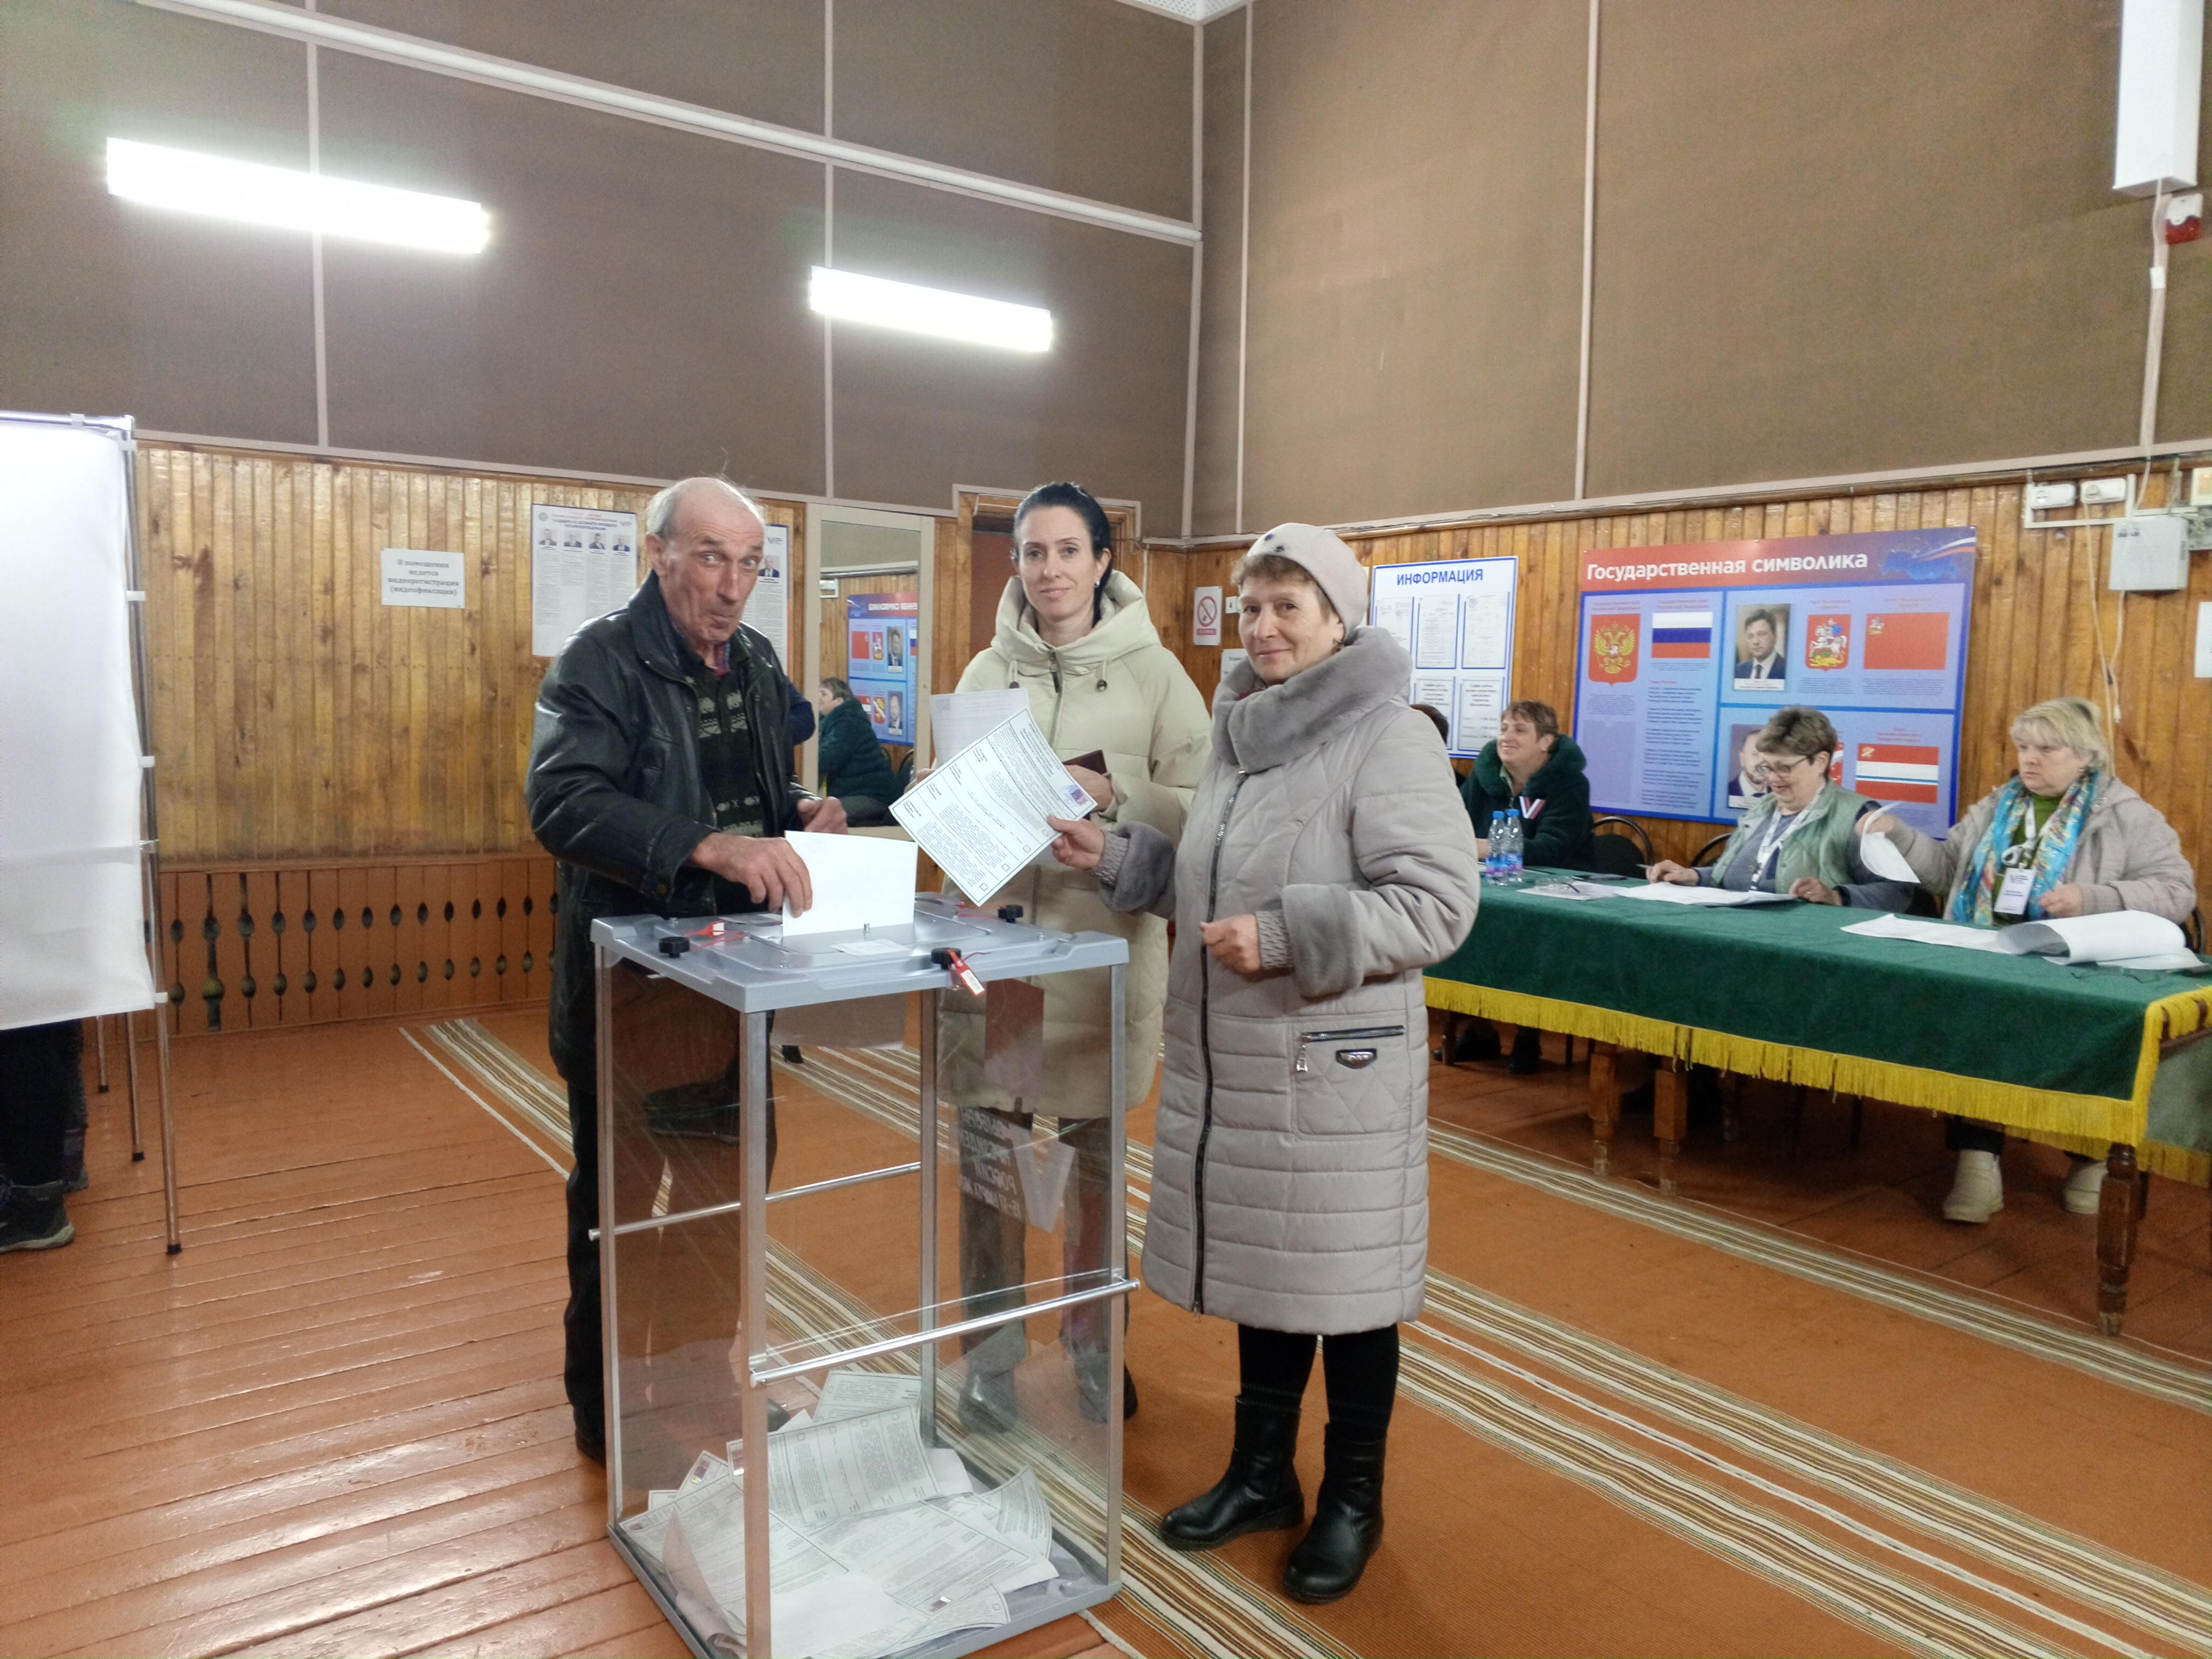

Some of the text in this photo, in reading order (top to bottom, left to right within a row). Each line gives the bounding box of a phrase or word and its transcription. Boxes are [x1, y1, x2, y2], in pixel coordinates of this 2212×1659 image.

[1397, 569, 1483, 586] ИНФОРМАЦИЯ
[1587, 554, 1868, 581] Государственная символика
